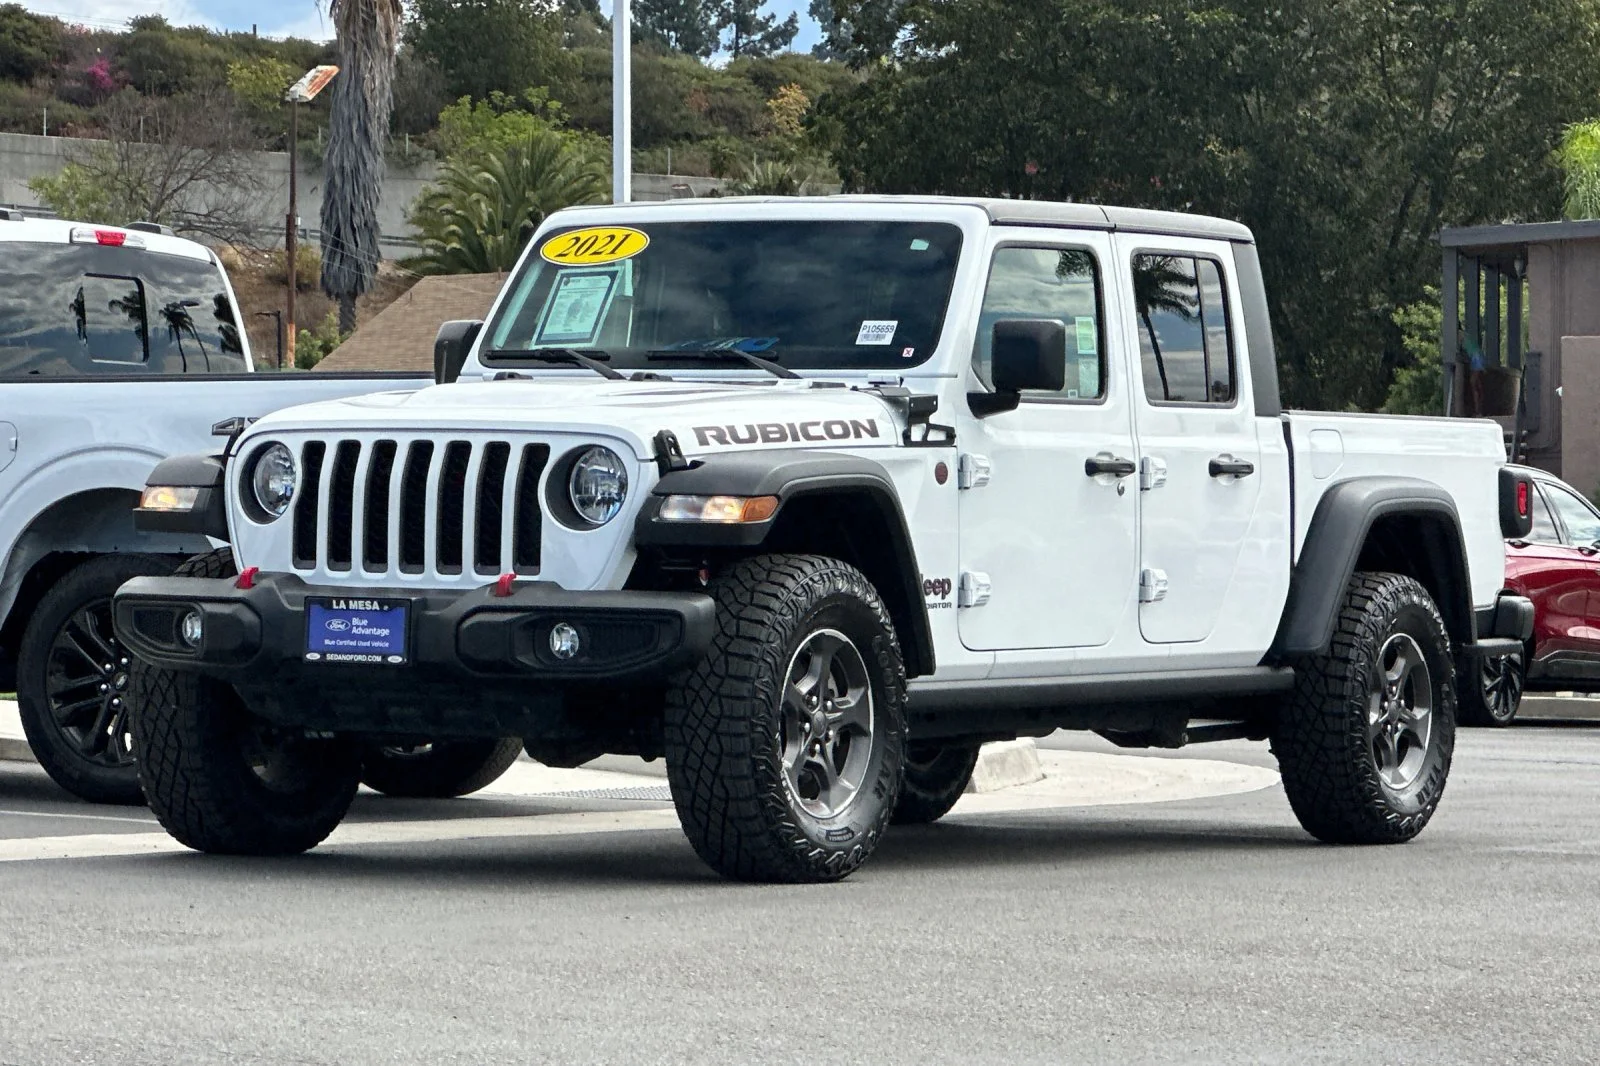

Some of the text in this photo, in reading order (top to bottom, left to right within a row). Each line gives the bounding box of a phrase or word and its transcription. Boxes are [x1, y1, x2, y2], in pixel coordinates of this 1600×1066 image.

[554, 233, 632, 257] 2021
[862, 324, 895, 333] P105659
[692, 418, 880, 447] RUBICON
[920, 573, 951, 600] eep
[332, 600, 346, 609] LA
[349, 601, 380, 611] MESA
[352, 617, 368, 626] Blue
[352, 626, 390, 637] Advantage
[326, 653, 382, 662] SEDANOFORD.COM
